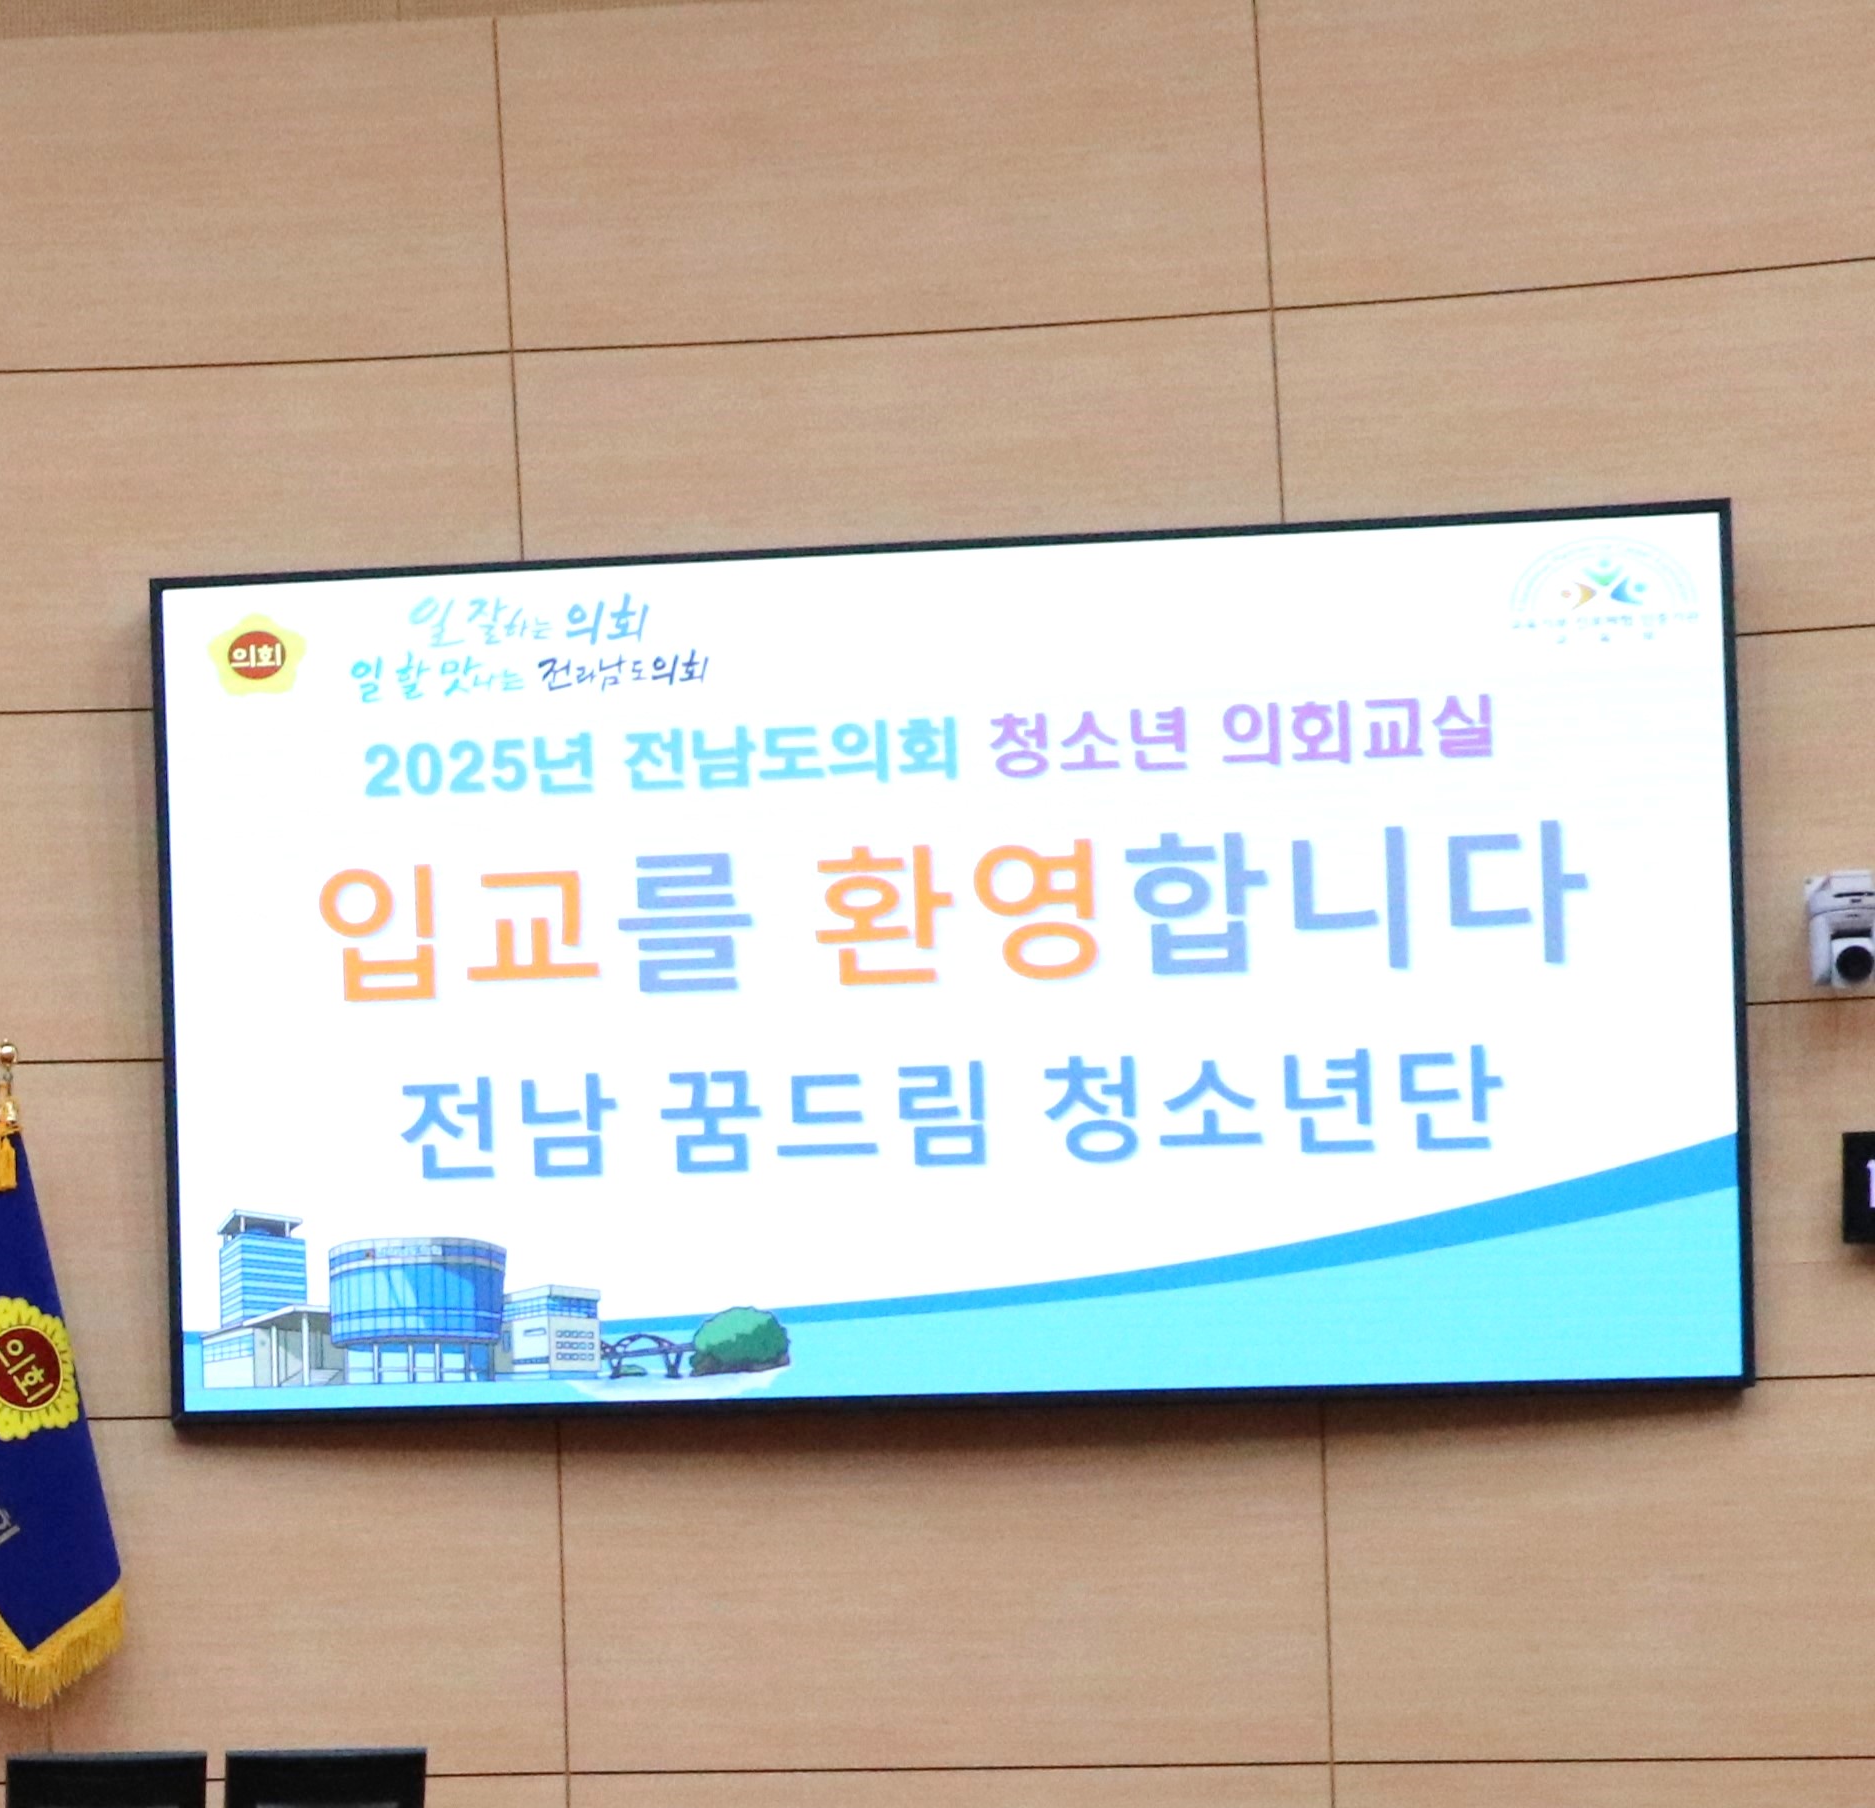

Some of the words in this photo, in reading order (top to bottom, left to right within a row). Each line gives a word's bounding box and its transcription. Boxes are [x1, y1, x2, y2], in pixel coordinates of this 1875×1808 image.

[230, 643, 283, 669] 의회
[407, 595, 465, 648] 일
[467, 597, 549, 645] 잘하는
[566, 593, 649, 645] 의회
[538, 649, 708, 691] 전라남도의회
[365, 732, 593, 797] 2025년
[624, 716, 958, 791] 전남도의회
[990, 707, 1188, 779] 청소년
[1223, 694, 1493, 768] 의회교실
[320, 853, 753, 1001] 입교를
[817, 820, 1588, 985] 환영합니다
[401, 1073, 618, 1180] 전남
[661, 1061, 987, 1174] 꿈드림
[1044, 1045, 1504, 1164] 청소년단
